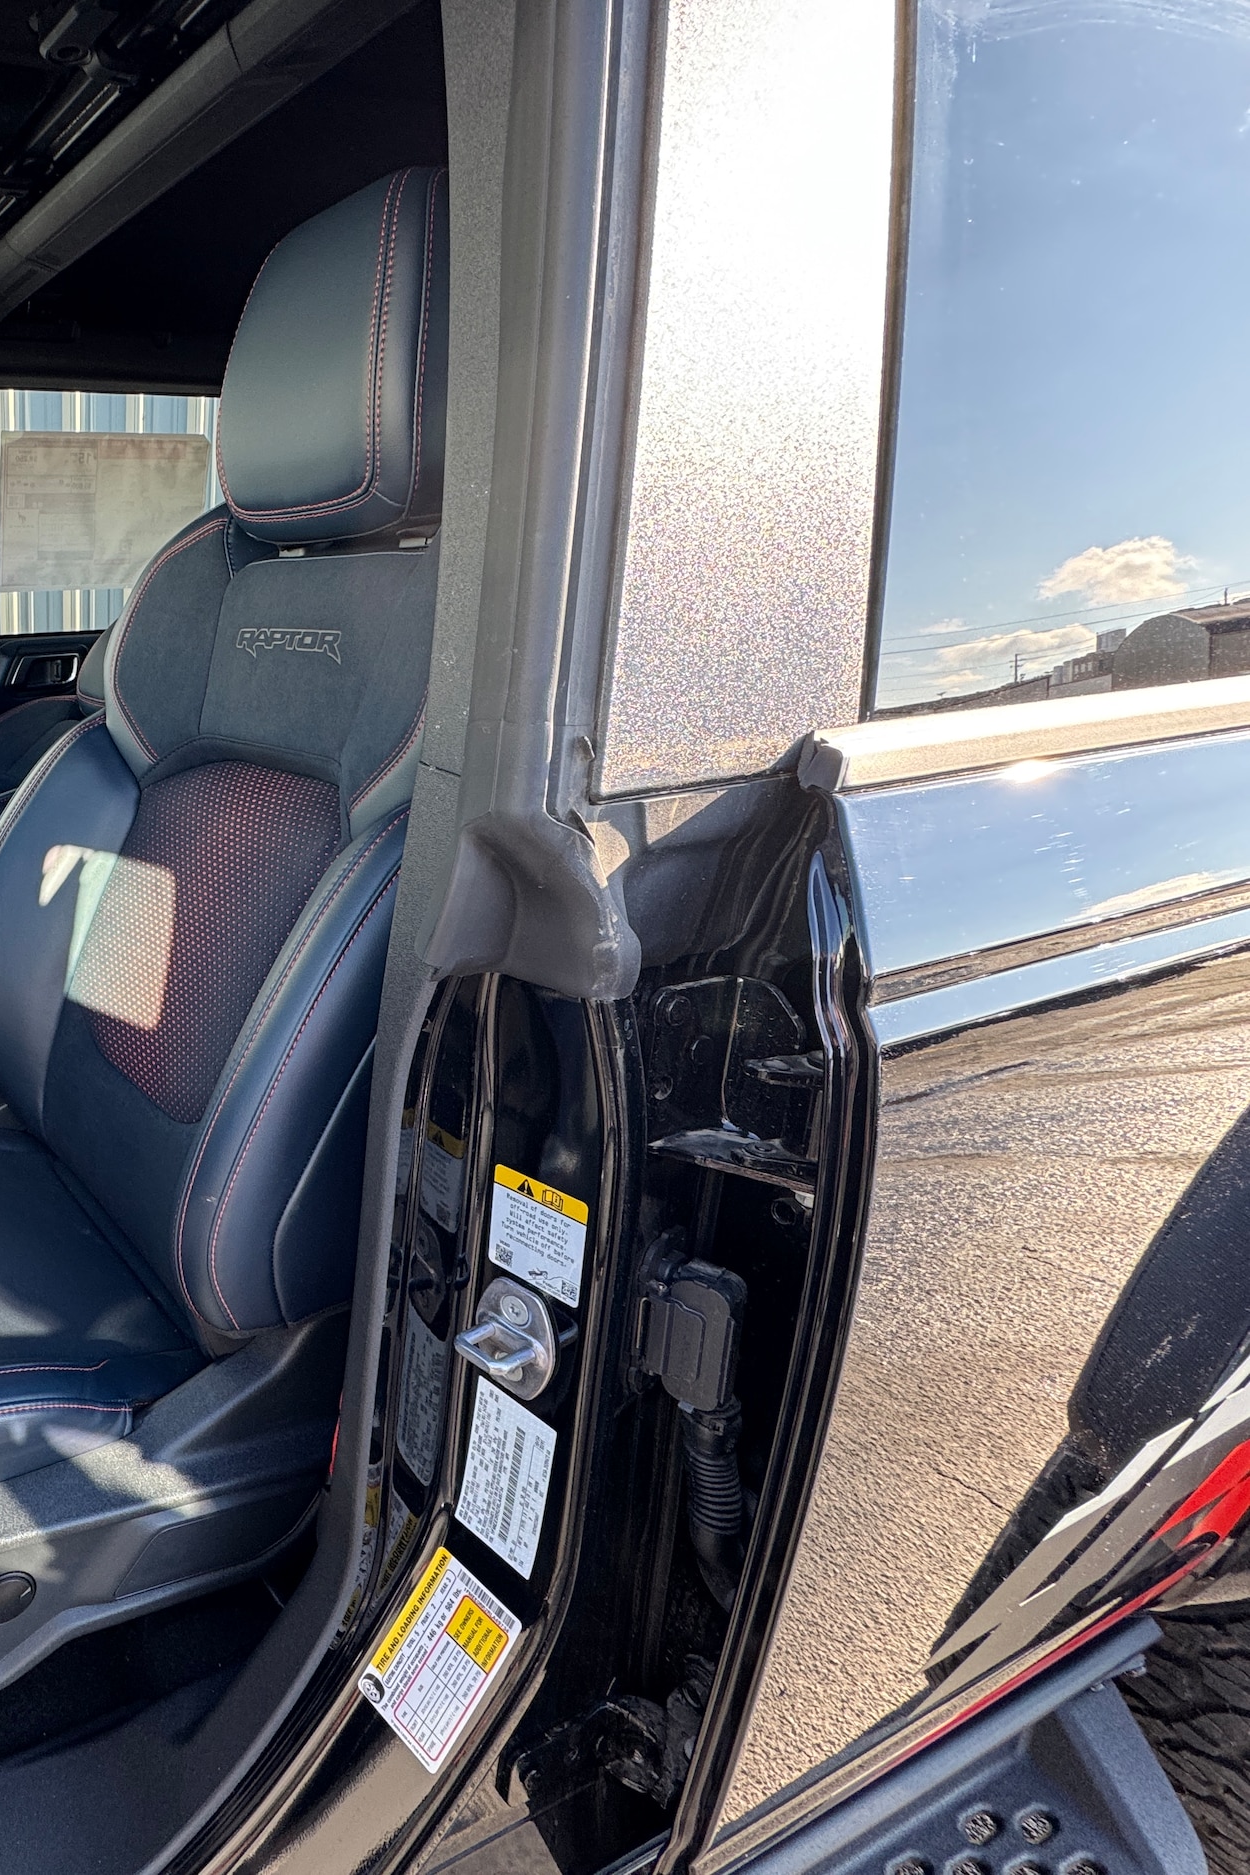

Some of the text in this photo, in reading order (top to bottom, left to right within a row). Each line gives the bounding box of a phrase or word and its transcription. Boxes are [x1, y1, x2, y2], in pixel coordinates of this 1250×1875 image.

[236, 628, 341, 665] RAPTOR
[506, 1192, 528, 1208] Removal
[540, 1209, 557, 1222] doors
[560, 1219, 570, 1228] for
[509, 1203, 568, 1235] off-road use only.
[509, 1209, 568, 1244] Will affect safety
[501, 1220, 514, 1231] Turn
[516, 1229, 538, 1245] vehicle
[540, 1242, 550, 1250] off
[553, 1248, 574, 1263] before
[505, 1216, 525, 1230] system
[527, 1227, 566, 1250] performance.
[505, 1232, 544, 1257] reconnecting
[546, 1253, 566, 1267] doors.
[375, 1652, 390, 1671] TIRE
[387, 1636, 399, 1654] AND
[396, 1604, 419, 1637] LOADING
[416, 1553, 448, 1605] INFORMATION
[426, 1628, 436, 1641] 446
[434, 1620, 443, 1629] kg
[440, 1612, 446, 1620] or
[453, 1607, 474, 1640] SEE OWNERS
[461, 1616, 483, 1649] MANUAL FOR
[472, 1627, 492, 1658] ADDITIONAL
[480, 1632, 503, 1668] INFORMATION
[380, 1702, 388, 1711] The
